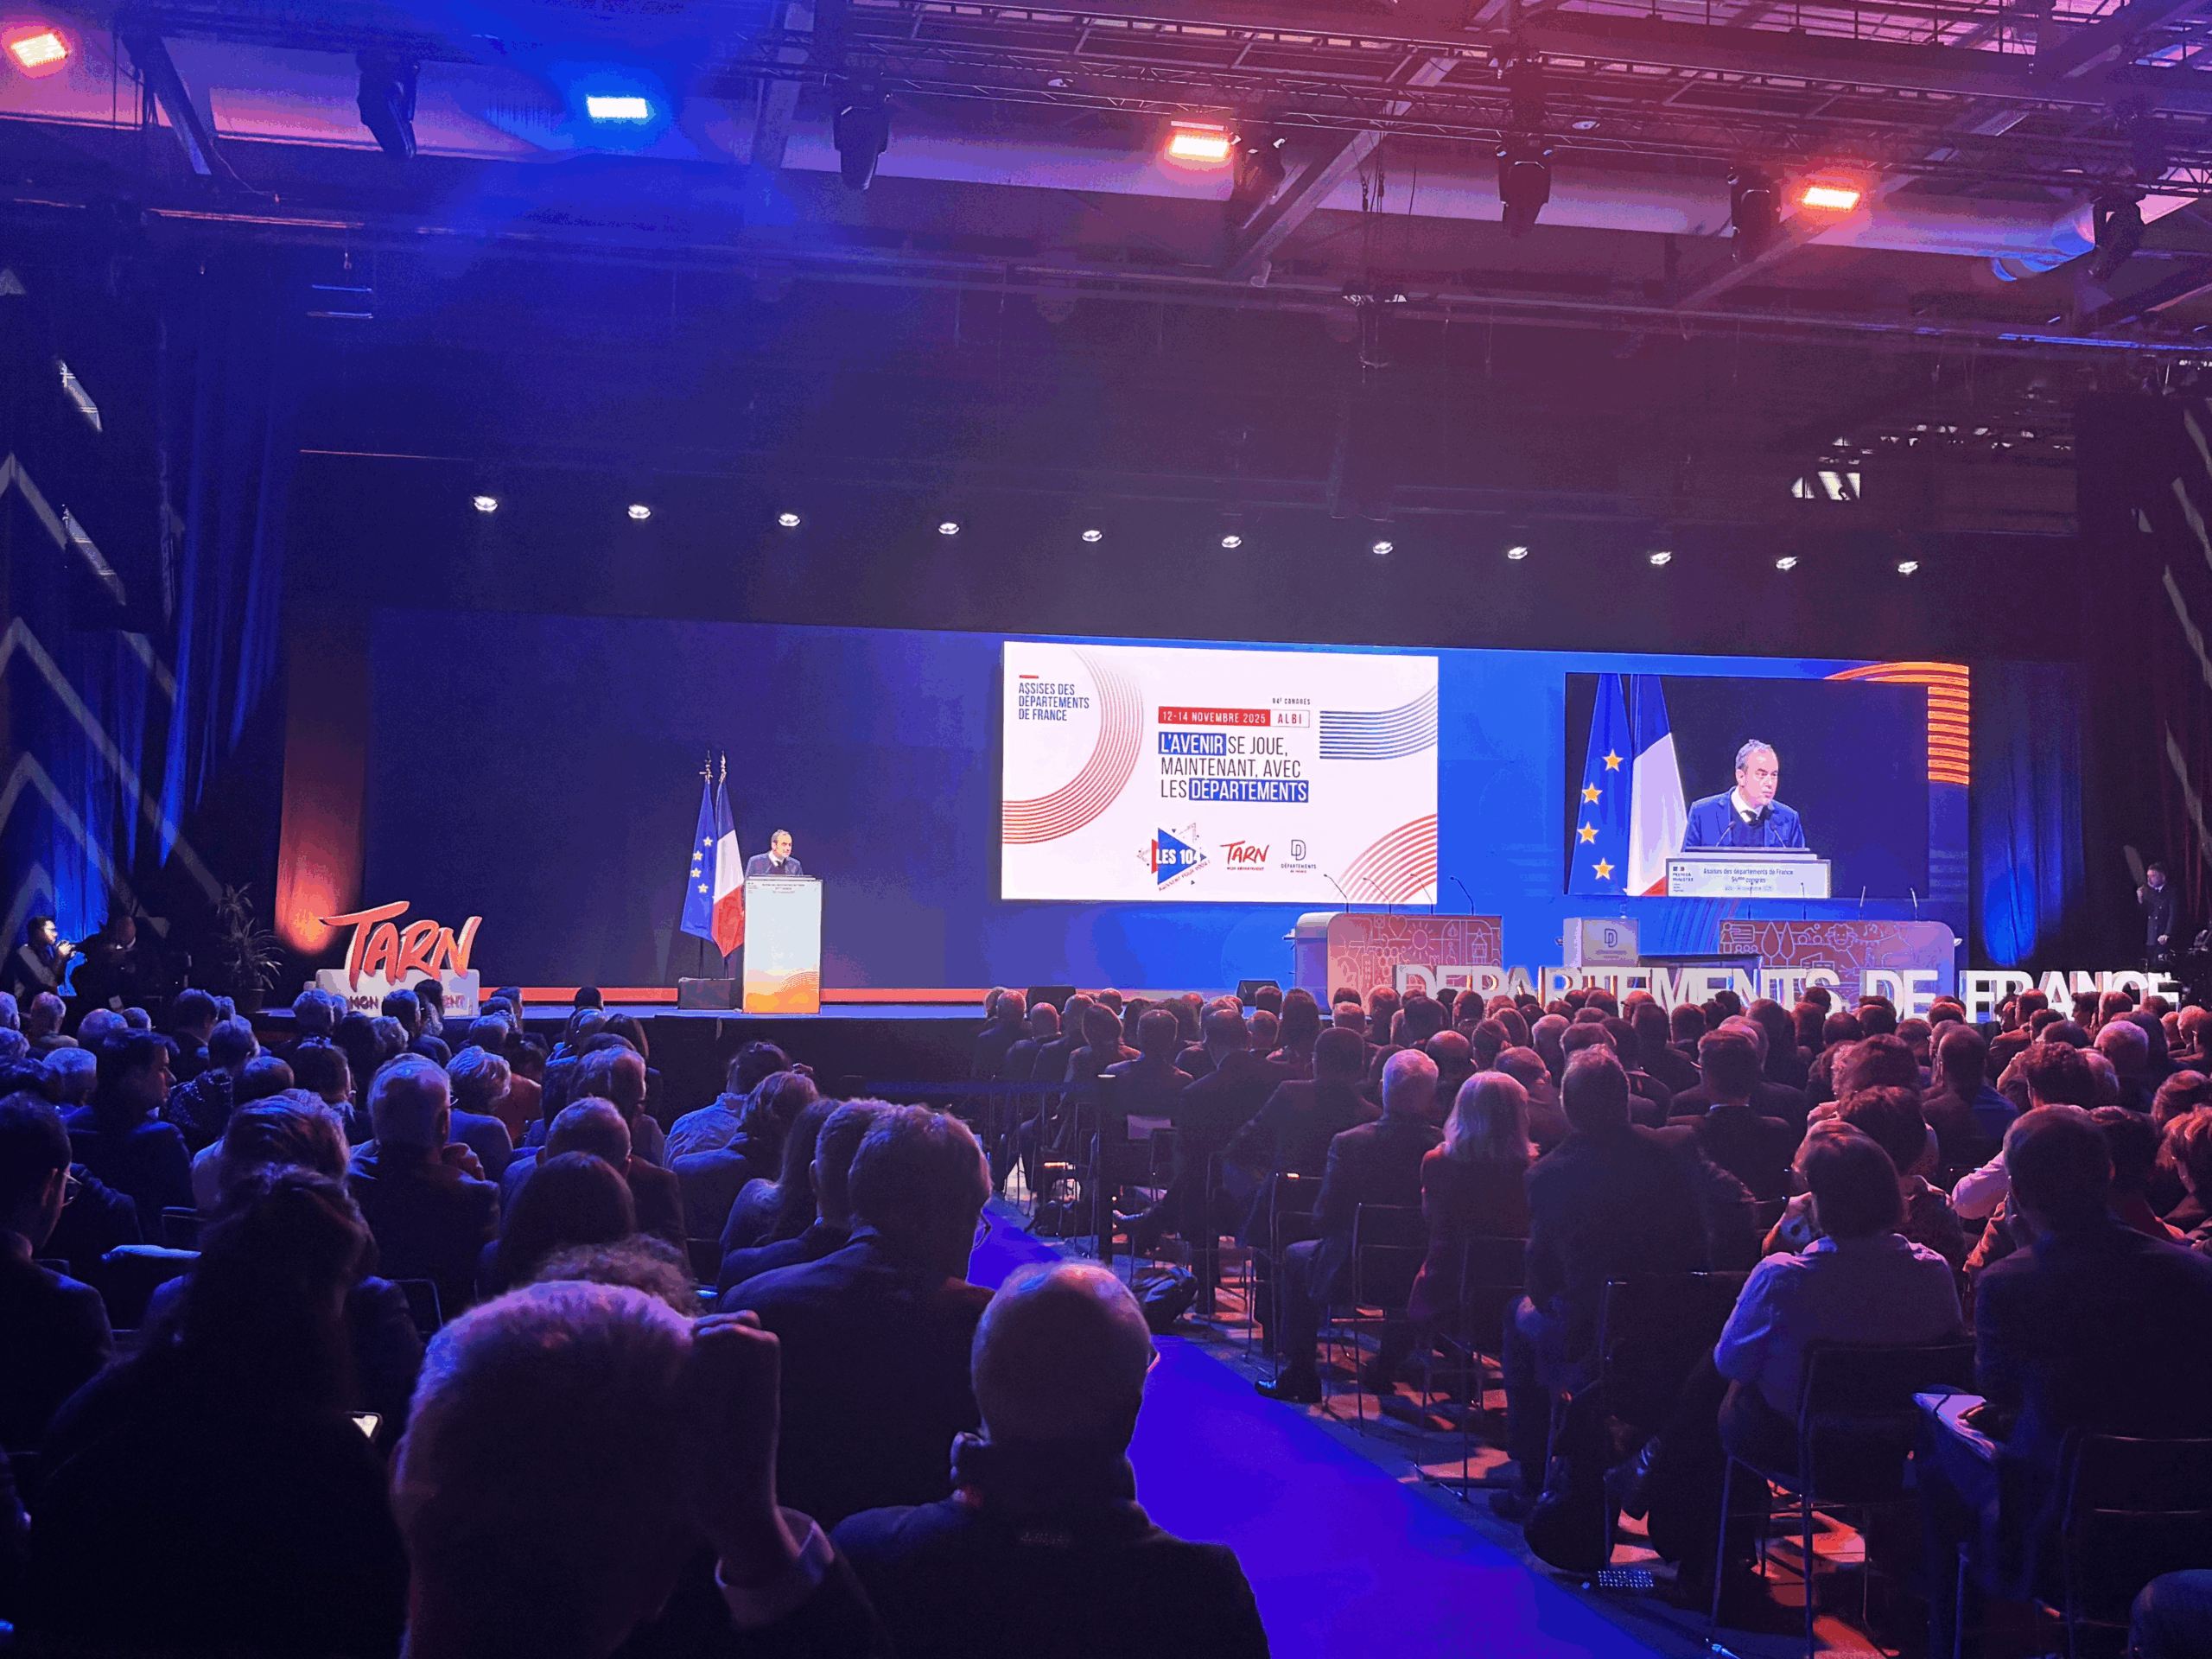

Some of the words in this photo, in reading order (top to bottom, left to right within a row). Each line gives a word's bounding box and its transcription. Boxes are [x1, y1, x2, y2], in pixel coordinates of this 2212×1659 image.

[1018, 682, 1056, 695] ASSISES
[1058, 683, 1075, 696] DES
[1019, 708, 1030, 720] DE
[1033, 709, 1067, 721] FRANCE
[1192, 711, 1239, 723] NOVEMBRE
[1243, 713, 1266, 724] 2025
[1277, 713, 1302, 724] ALBI
[1160, 734, 1224, 754] L'AVENIR
[1228, 736, 1245, 754] SE
[1249, 736, 1287, 757] JOUE,
[1161, 757, 1258, 778] MAINTENANT,
[1263, 760, 1300, 778] AVEC
[1161, 779, 1187, 798] LES
[1156, 849, 1177, 864] LES
[1219, 840, 1270, 865] TARN
[318, 900, 483, 993] TARN
[346, 995, 379, 1010] MON
[1859, 969, 1938, 1021] DE
